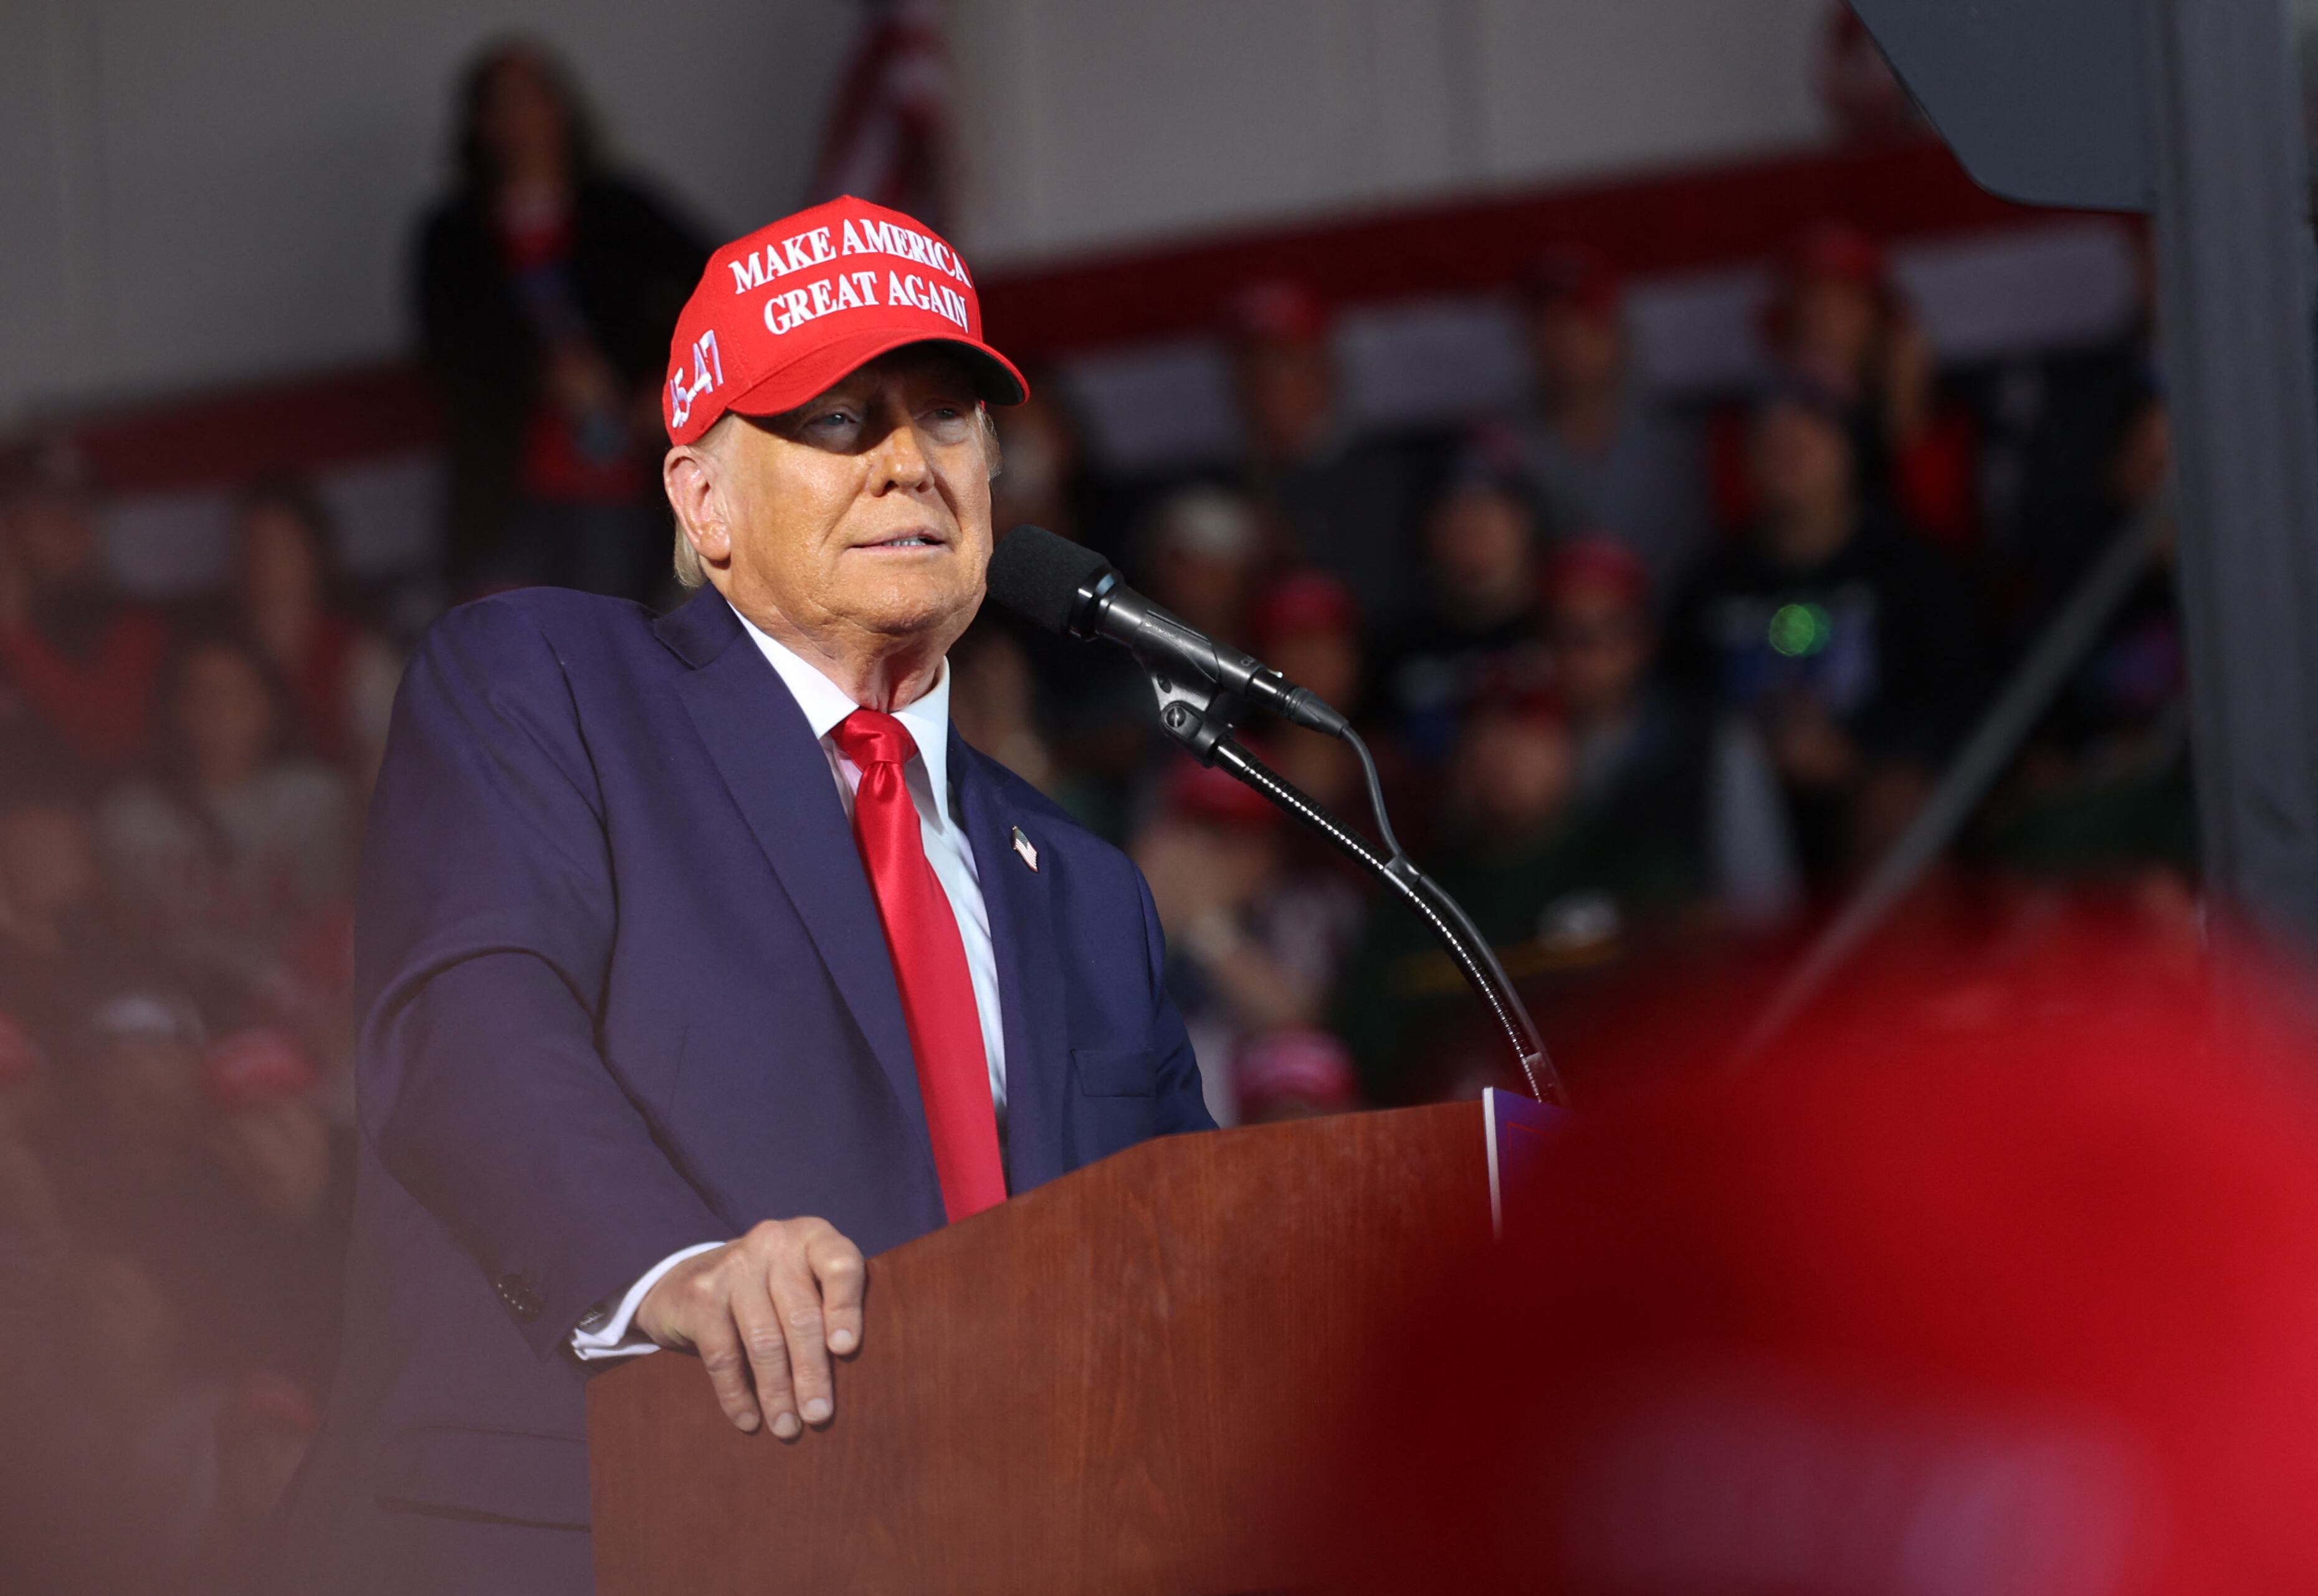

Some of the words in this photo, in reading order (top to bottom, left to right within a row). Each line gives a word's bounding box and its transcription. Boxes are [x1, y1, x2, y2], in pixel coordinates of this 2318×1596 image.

[728, 226, 837, 295] MAKE
[841, 219, 973, 289] AMERICA
[763, 271, 879, 335] GREAT
[887, 270, 969, 334] AGAIN
